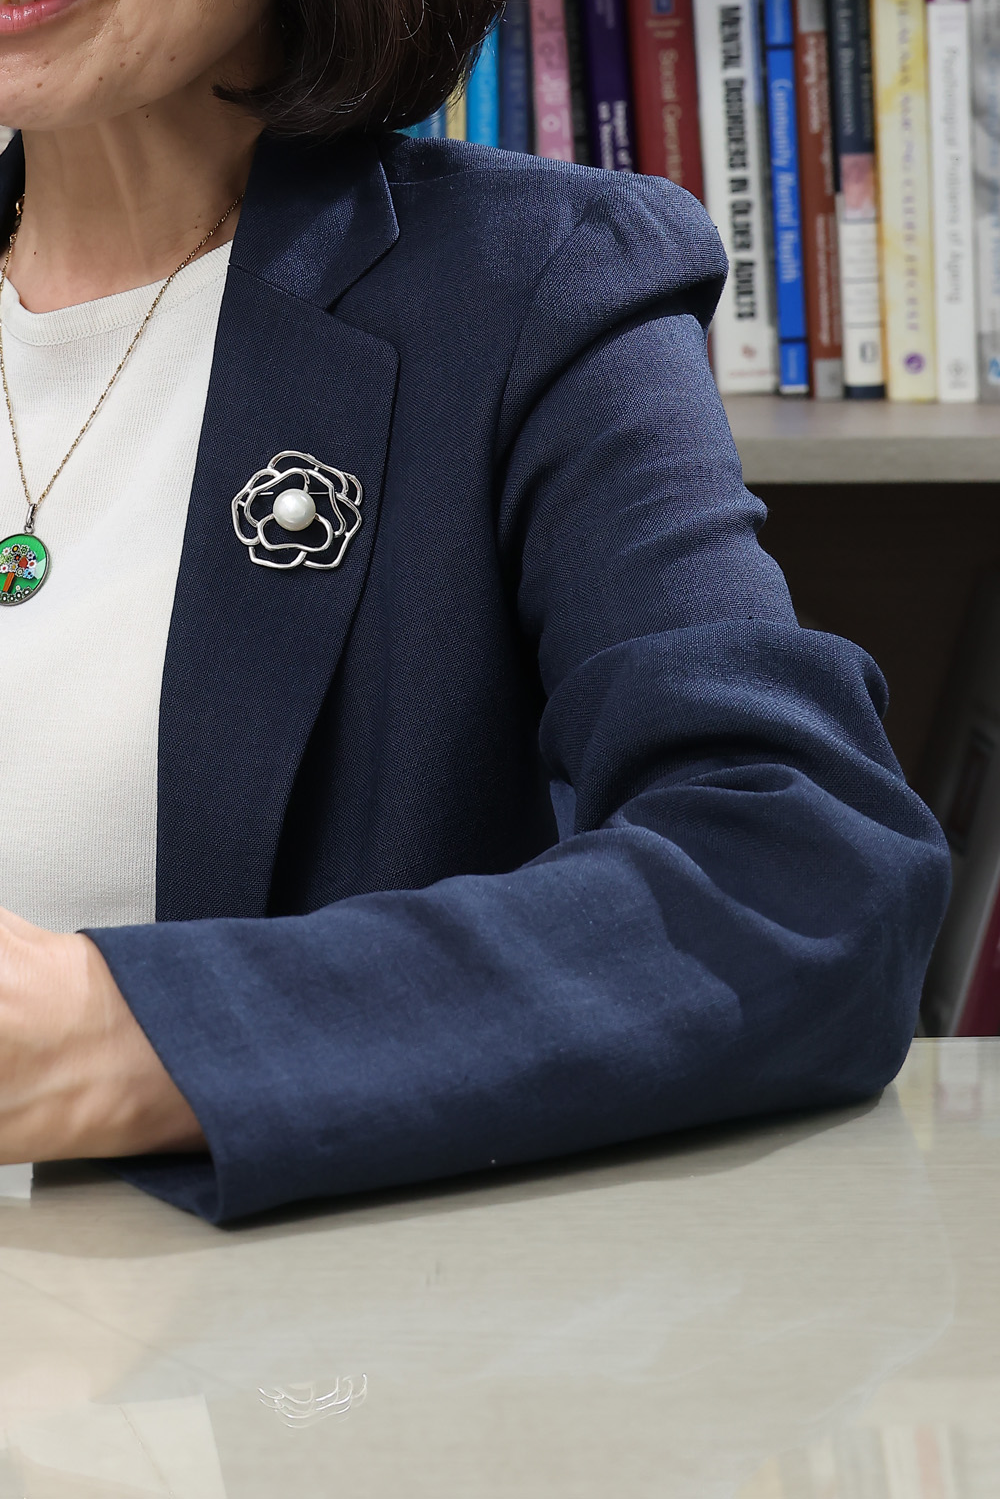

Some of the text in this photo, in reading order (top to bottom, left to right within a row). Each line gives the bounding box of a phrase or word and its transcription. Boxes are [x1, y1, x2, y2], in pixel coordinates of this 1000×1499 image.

[658, 49, 678, 100] Social
[719, 5, 758, 320] MENTAL DISORDERS IN OLDER ADULTS
[770, 79, 802, 282] Community Mental Health
[942, 47, 967, 304] Psychological Problems of Ageing
